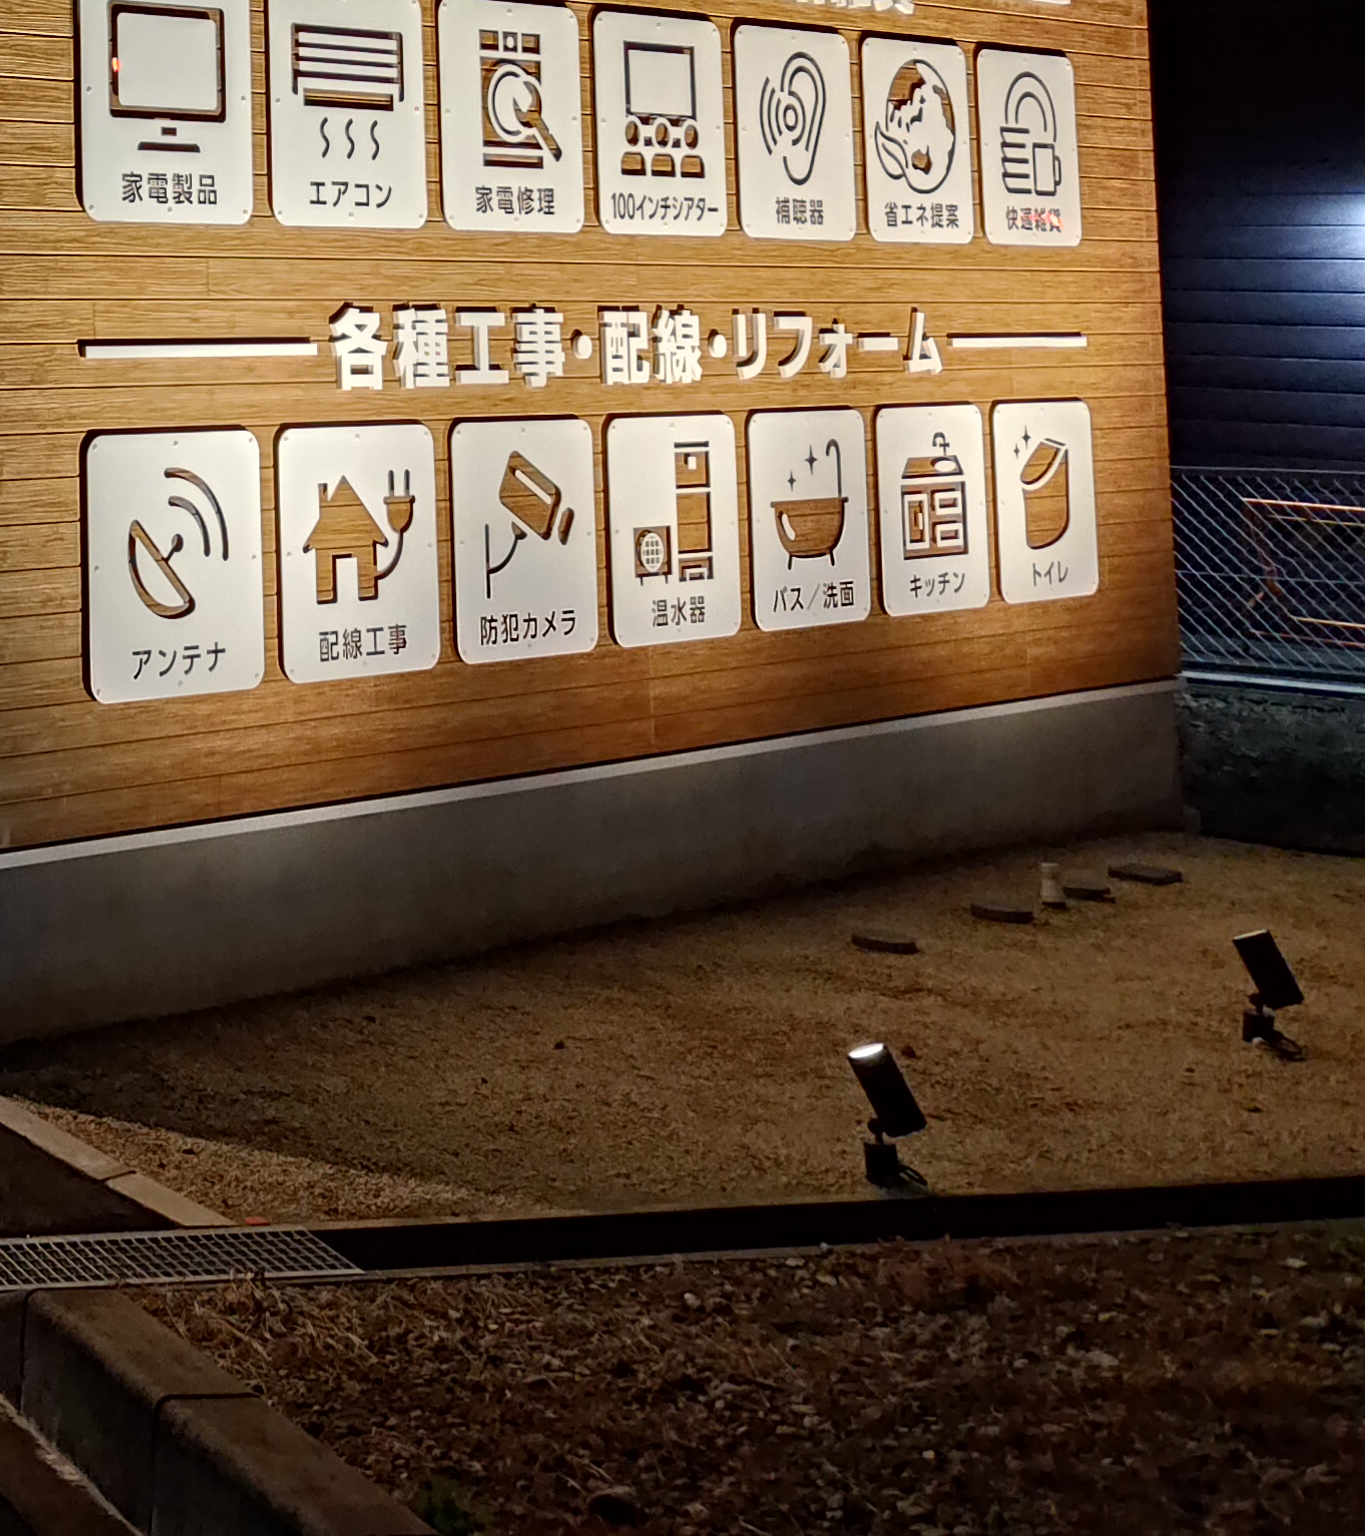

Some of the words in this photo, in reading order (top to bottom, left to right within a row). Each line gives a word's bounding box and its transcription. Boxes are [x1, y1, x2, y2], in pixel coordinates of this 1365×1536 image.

[121, 171, 218, 205] 家電製品
[309, 179, 393, 209] エアコン
[474, 185, 556, 216] 家電修理
[610, 192, 719, 222] 100インチシアター
[774, 197, 825, 226] 補聴器
[883, 200, 960, 229] 省エネ提案
[909, 571, 966, 598] キッチン
[1032, 560, 1069, 586] トイレ
[651, 595, 707, 628] 温水器
[318, 623, 408, 662] 配線工事
[479, 609, 577, 646] 防犯カメラ
[130, 640, 227, 681] アンテナ
